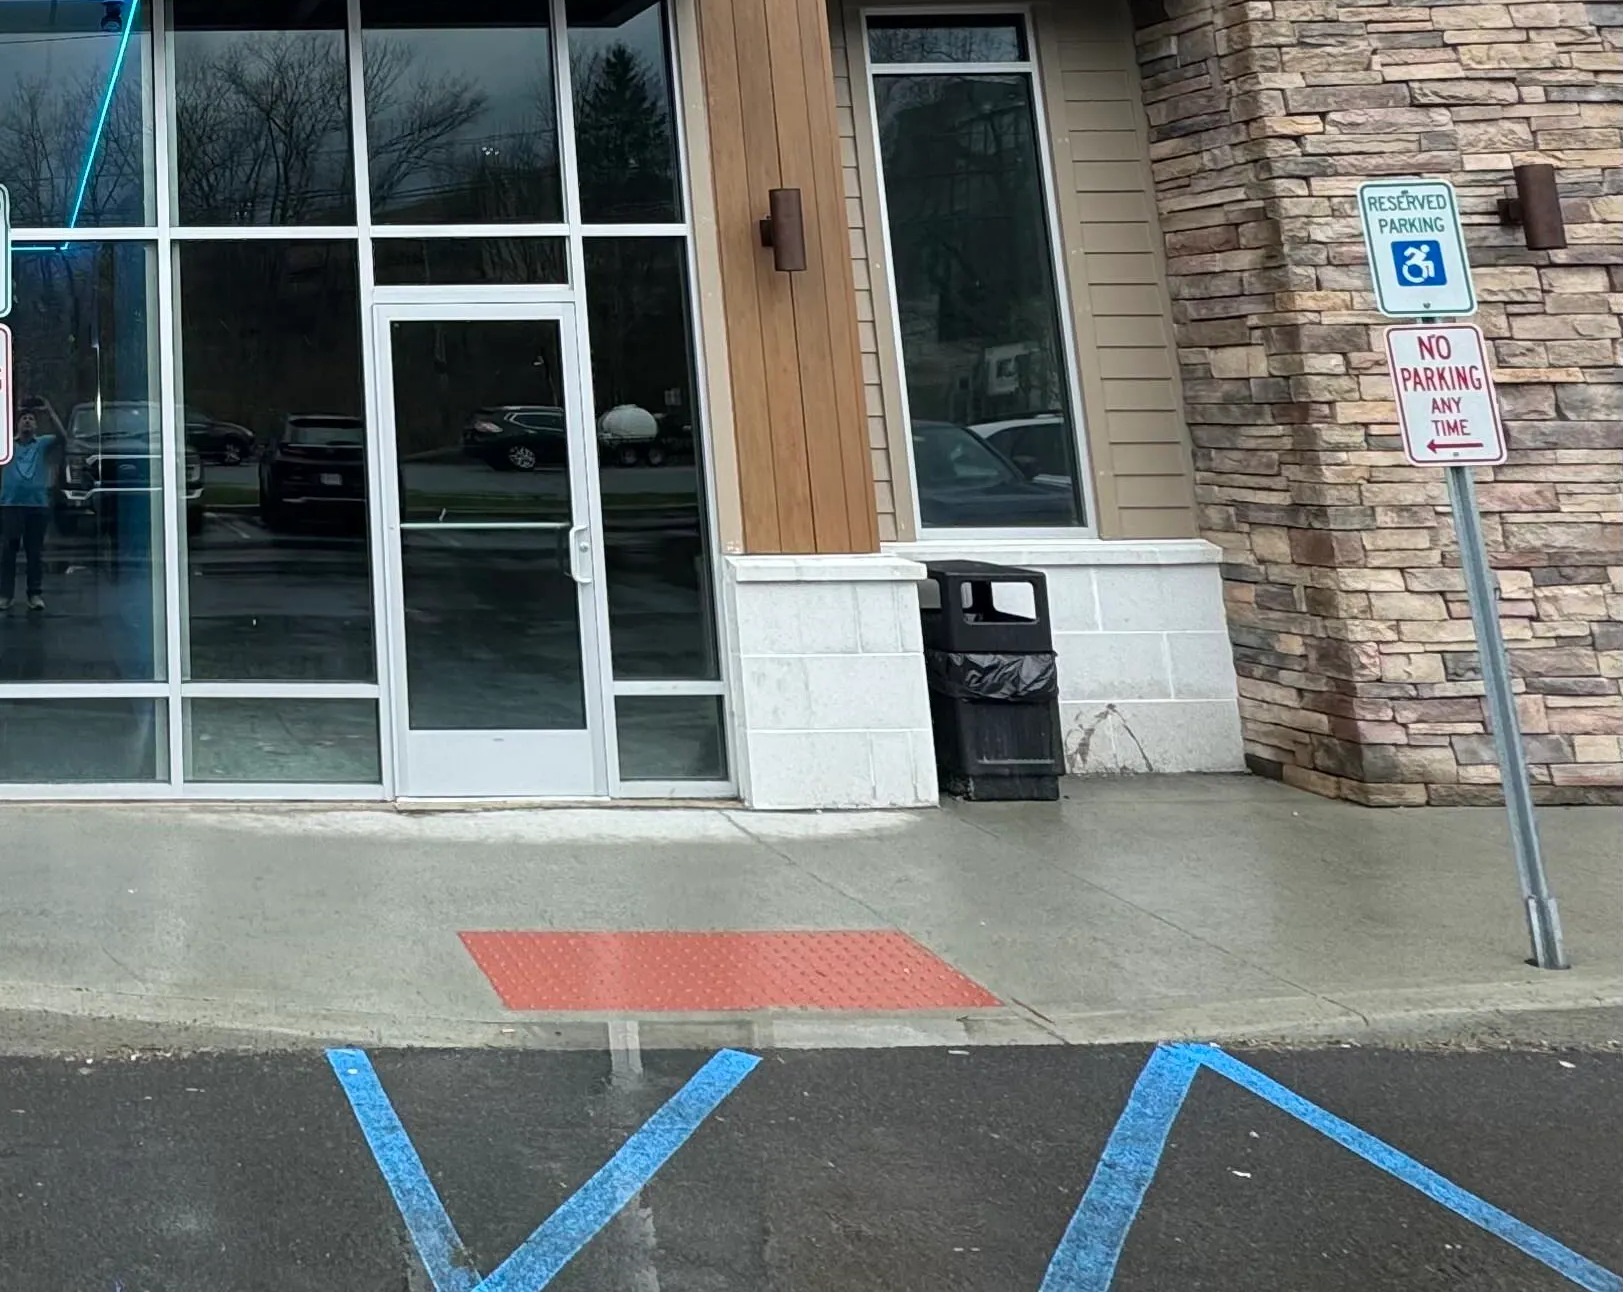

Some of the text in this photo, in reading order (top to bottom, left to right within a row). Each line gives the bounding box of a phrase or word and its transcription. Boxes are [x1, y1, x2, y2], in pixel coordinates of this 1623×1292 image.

[1367, 194, 1447, 212] RESERVED
[1378, 216, 1445, 234] PARKING
[1417, 334, 1452, 361] NO
[1400, 365, 1483, 392] PARKING
[1431, 396, 1462, 414] ANY
[1431, 419, 1471, 437] TIME
